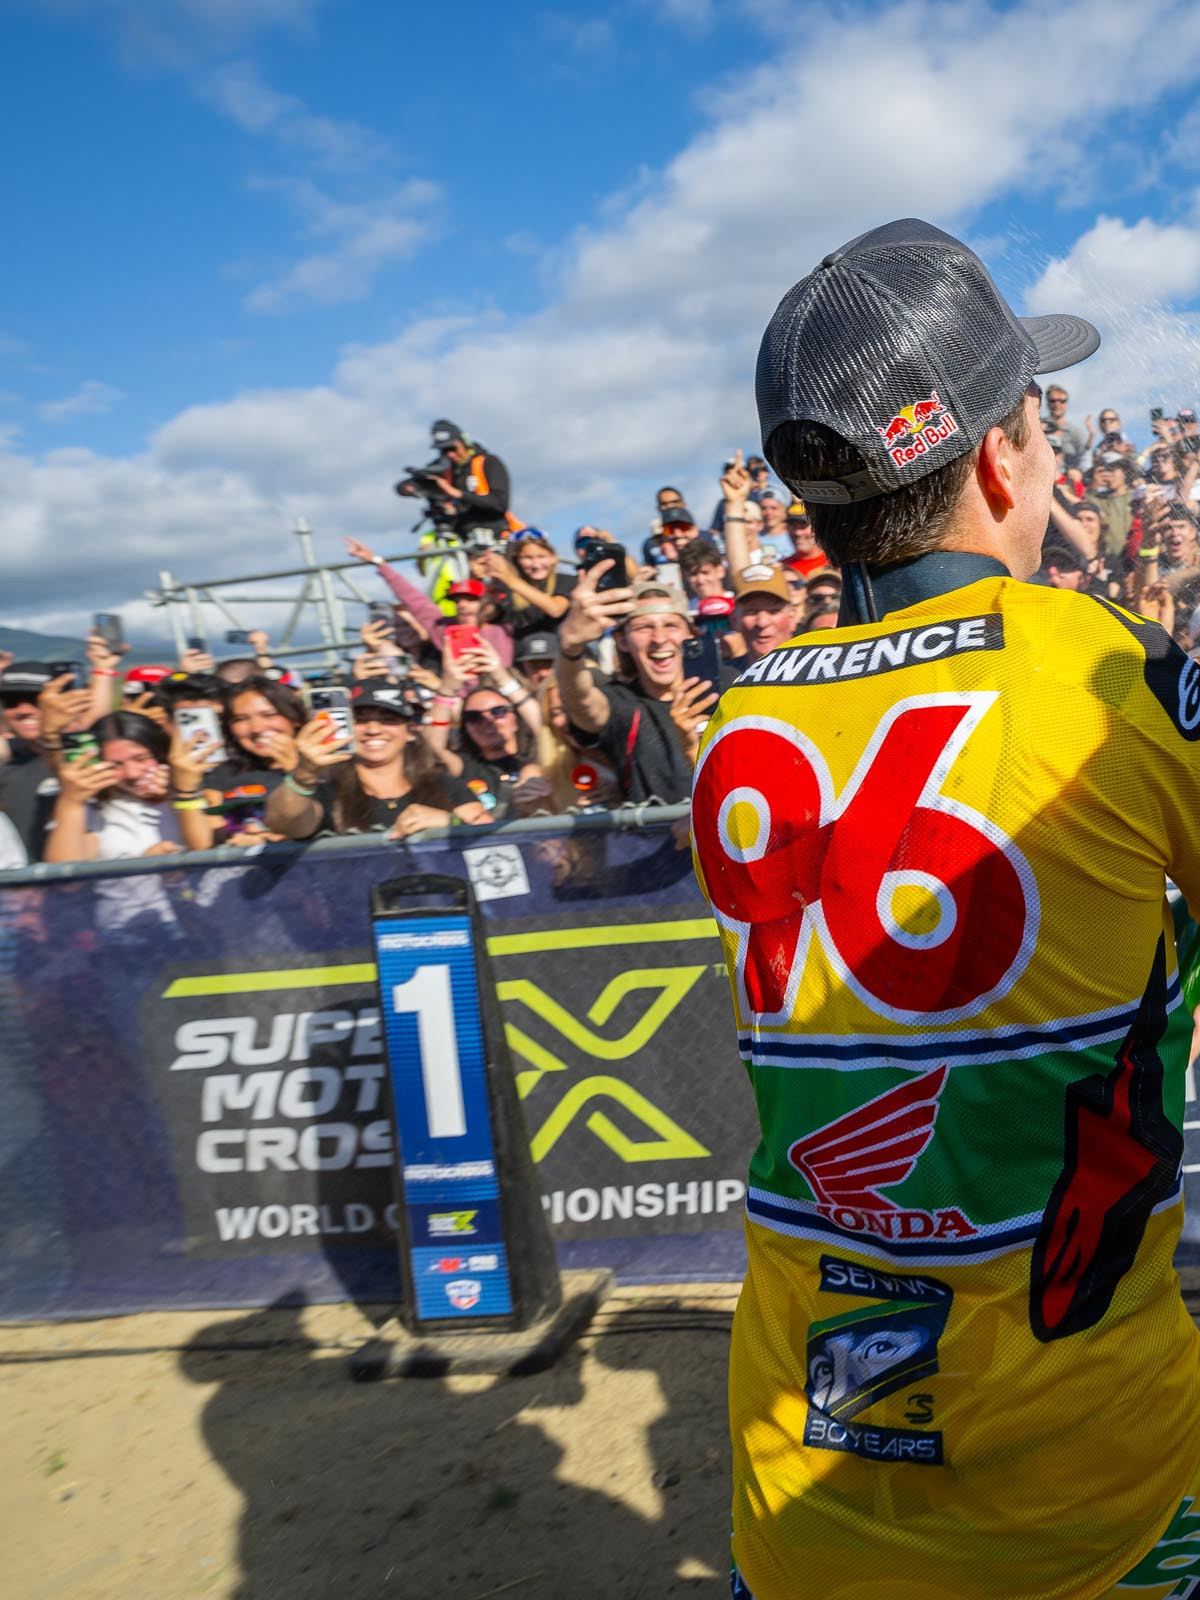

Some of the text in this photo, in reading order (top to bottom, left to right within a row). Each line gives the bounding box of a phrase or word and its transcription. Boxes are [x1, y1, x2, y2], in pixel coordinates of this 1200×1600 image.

[890, 412, 959, 467] Red Bull
[736, 618, 987, 684] AWRENCE
[691, 691, 1039, 1025] 96
[169, 1007, 382, 1071] SUPE
[393, 964, 467, 1138] 1
[202, 1063, 385, 1123] MOT
[196, 1119, 394, 1174] CROS
[216, 1202, 375, 1241] WORLD
